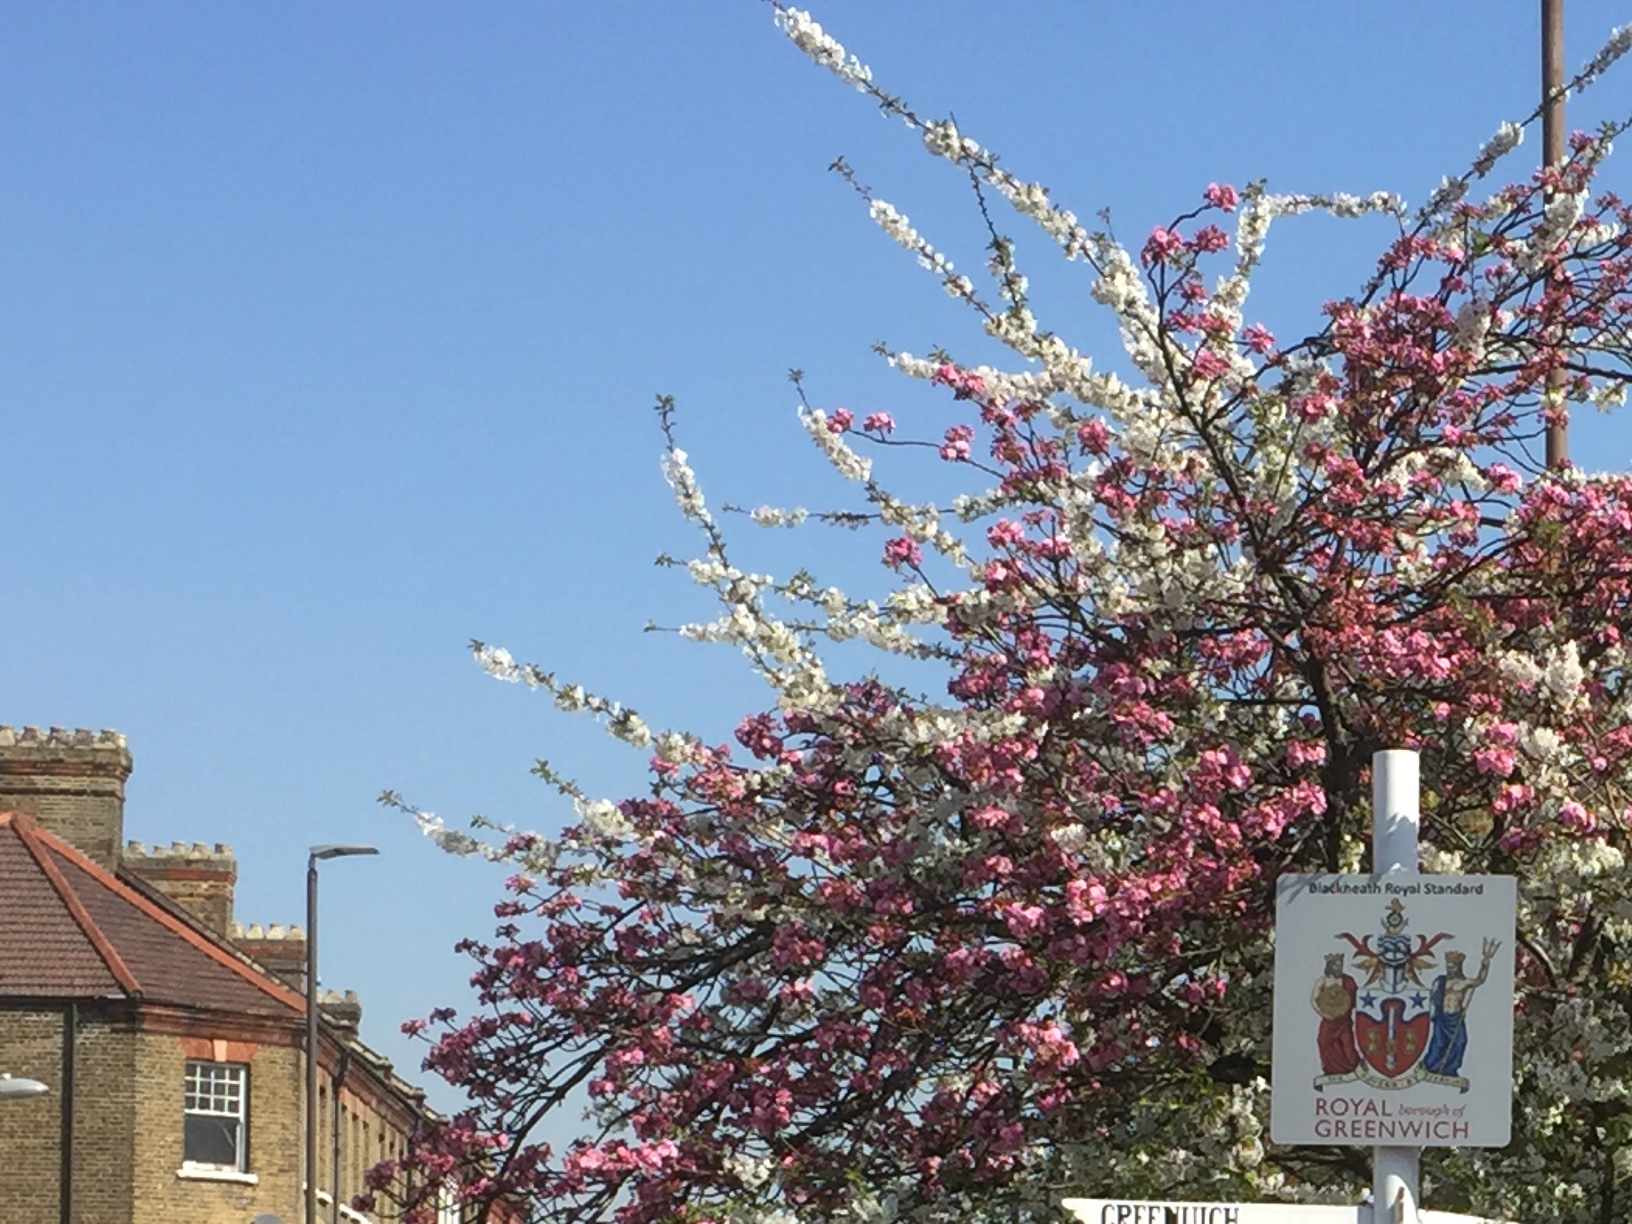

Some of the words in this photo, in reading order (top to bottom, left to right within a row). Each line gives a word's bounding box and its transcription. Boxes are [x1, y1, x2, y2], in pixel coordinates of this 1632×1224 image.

[1308, 881, 1381, 895] Blackheath
[1385, 882, 1421, 897] Royal
[1424, 883, 1484, 896] Standard
[1315, 1097, 1393, 1117] ROYAL
[1399, 1103, 1449, 1119] borough
[1453, 1103, 1467, 1119] of
[1314, 1119, 1470, 1140] GREENWICH
